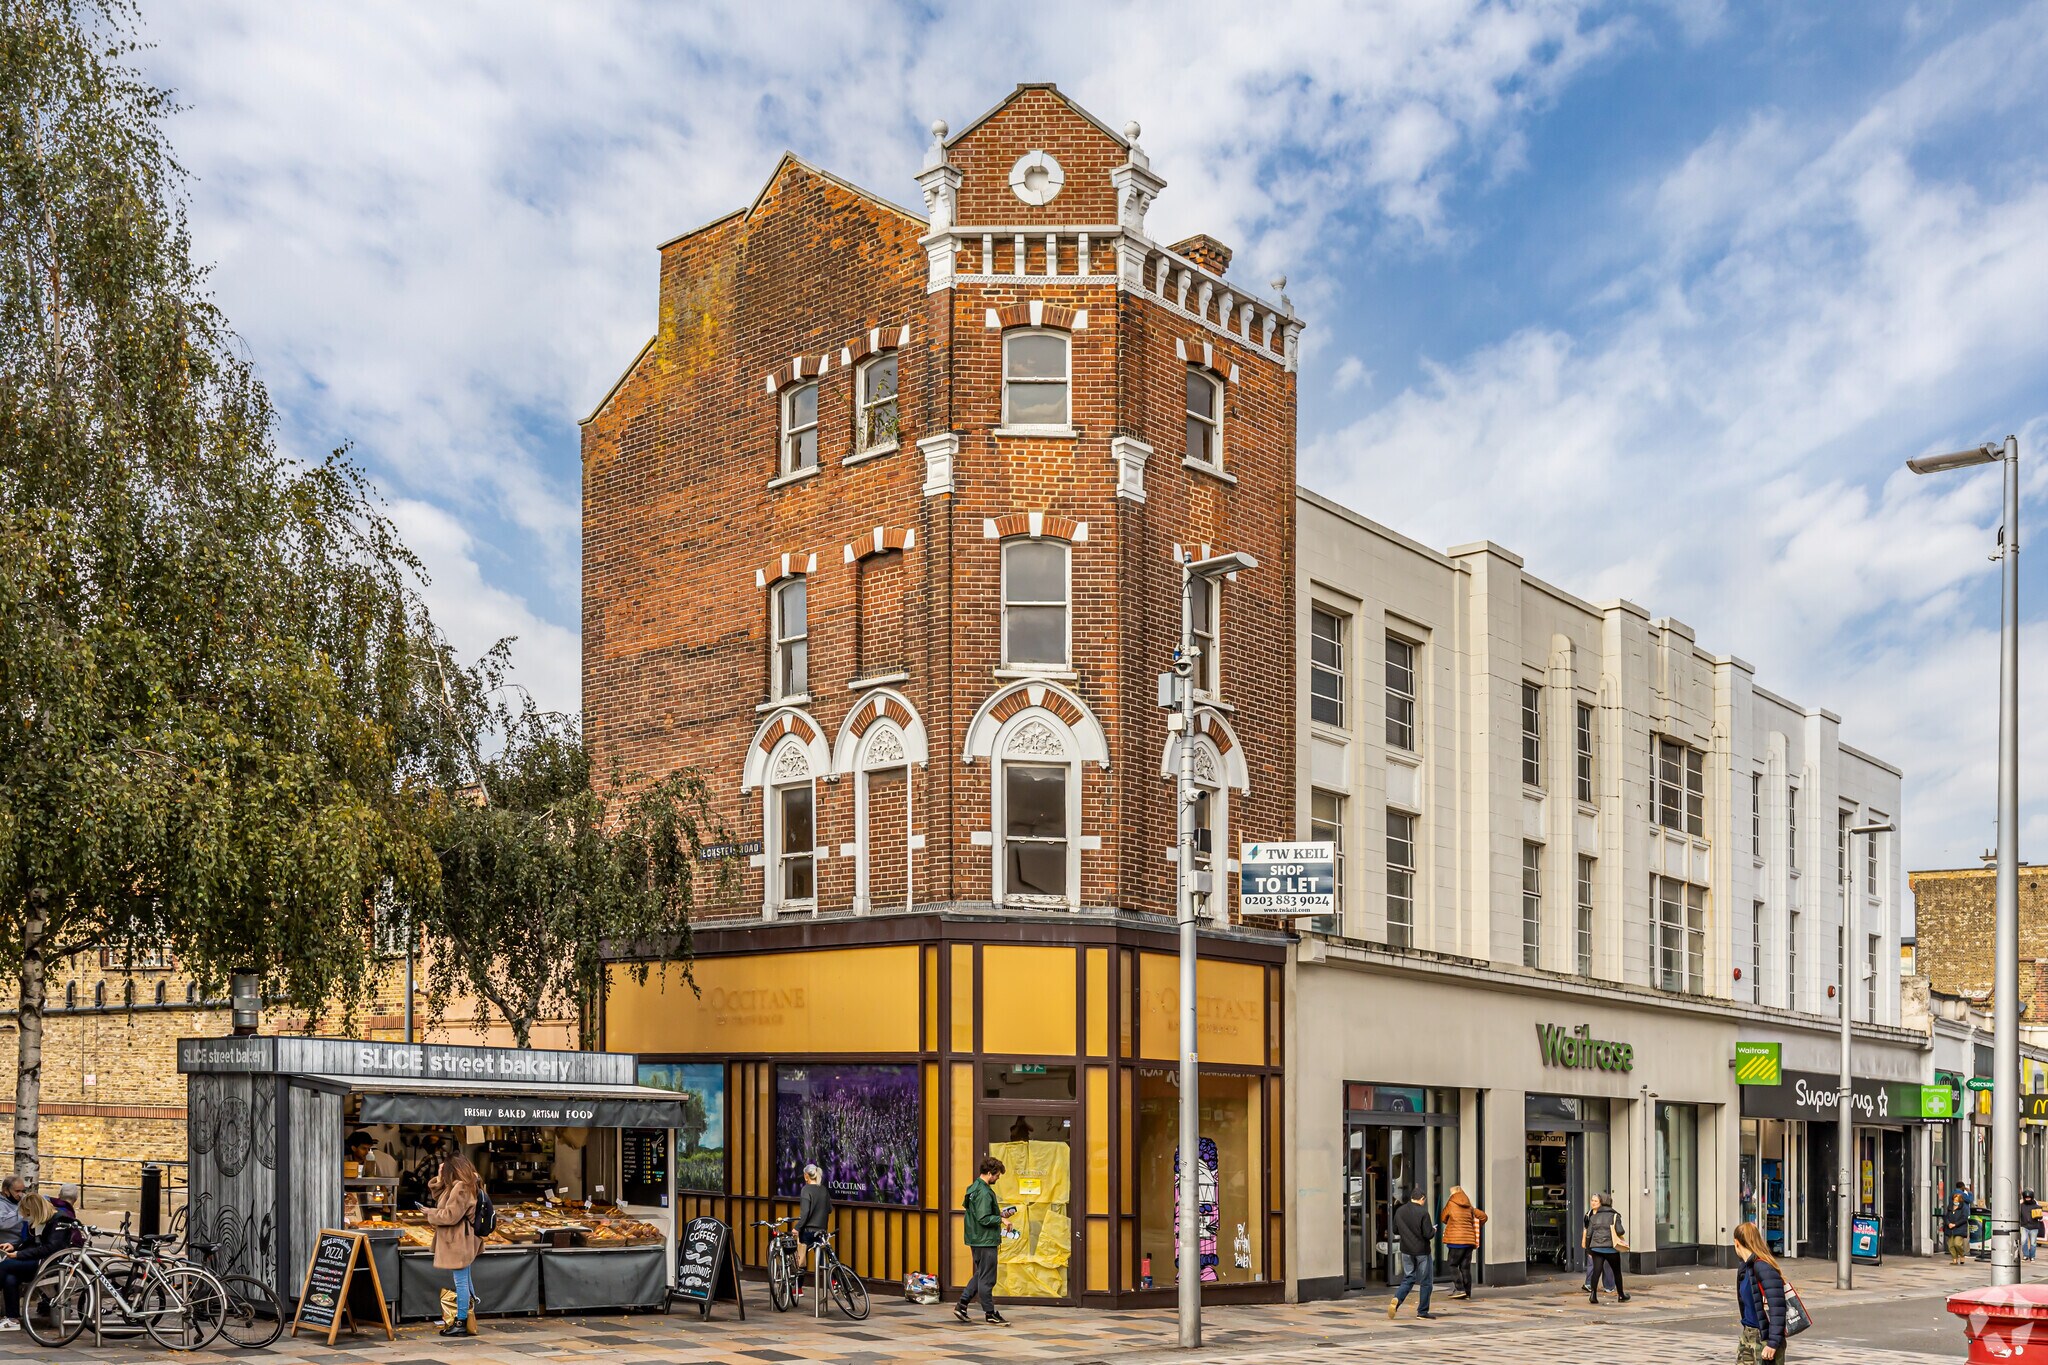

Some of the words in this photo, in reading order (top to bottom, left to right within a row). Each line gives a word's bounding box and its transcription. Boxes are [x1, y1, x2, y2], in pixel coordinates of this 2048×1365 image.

[1266, 849, 1290, 860] TW
[1293, 848, 1328, 859] KEIL
[1270, 865, 1304, 876] SHOP
[1255, 878, 1280, 893] TO
[1286, 877, 1320, 893] LET
[1245, 896, 1273, 906] 0203
[1275, 895, 1297, 906] 883
[1299, 896, 1330, 906] 9024
[1535, 1023, 1634, 1073] Waitrose
[1737, 1047, 1770, 1055] Waitrose
[183, 1048, 207, 1063] SLICE
[208, 1048, 234, 1063] street
[235, 1048, 266, 1067] bakery
[359, 1048, 424, 1070] SLICE
[429, 1051, 495, 1074] street
[500, 1054, 571, 1081] bakery
[1795, 1079, 1874, 1118] Superrug
[464, 1107, 492, 1117] FRESHLY
[498, 1109, 526, 1118] BAKED
[532, 1109, 560, 1119] ARTISAN
[566, 1110, 593, 1119] FOOD
[1526, 1132, 1564, 1144] Clapham
[828, 1180, 866, 1190] L'OCCITANE
[689, 1230, 719, 1246] COFFEE!
[324, 1246, 344, 1260] PIZZA
